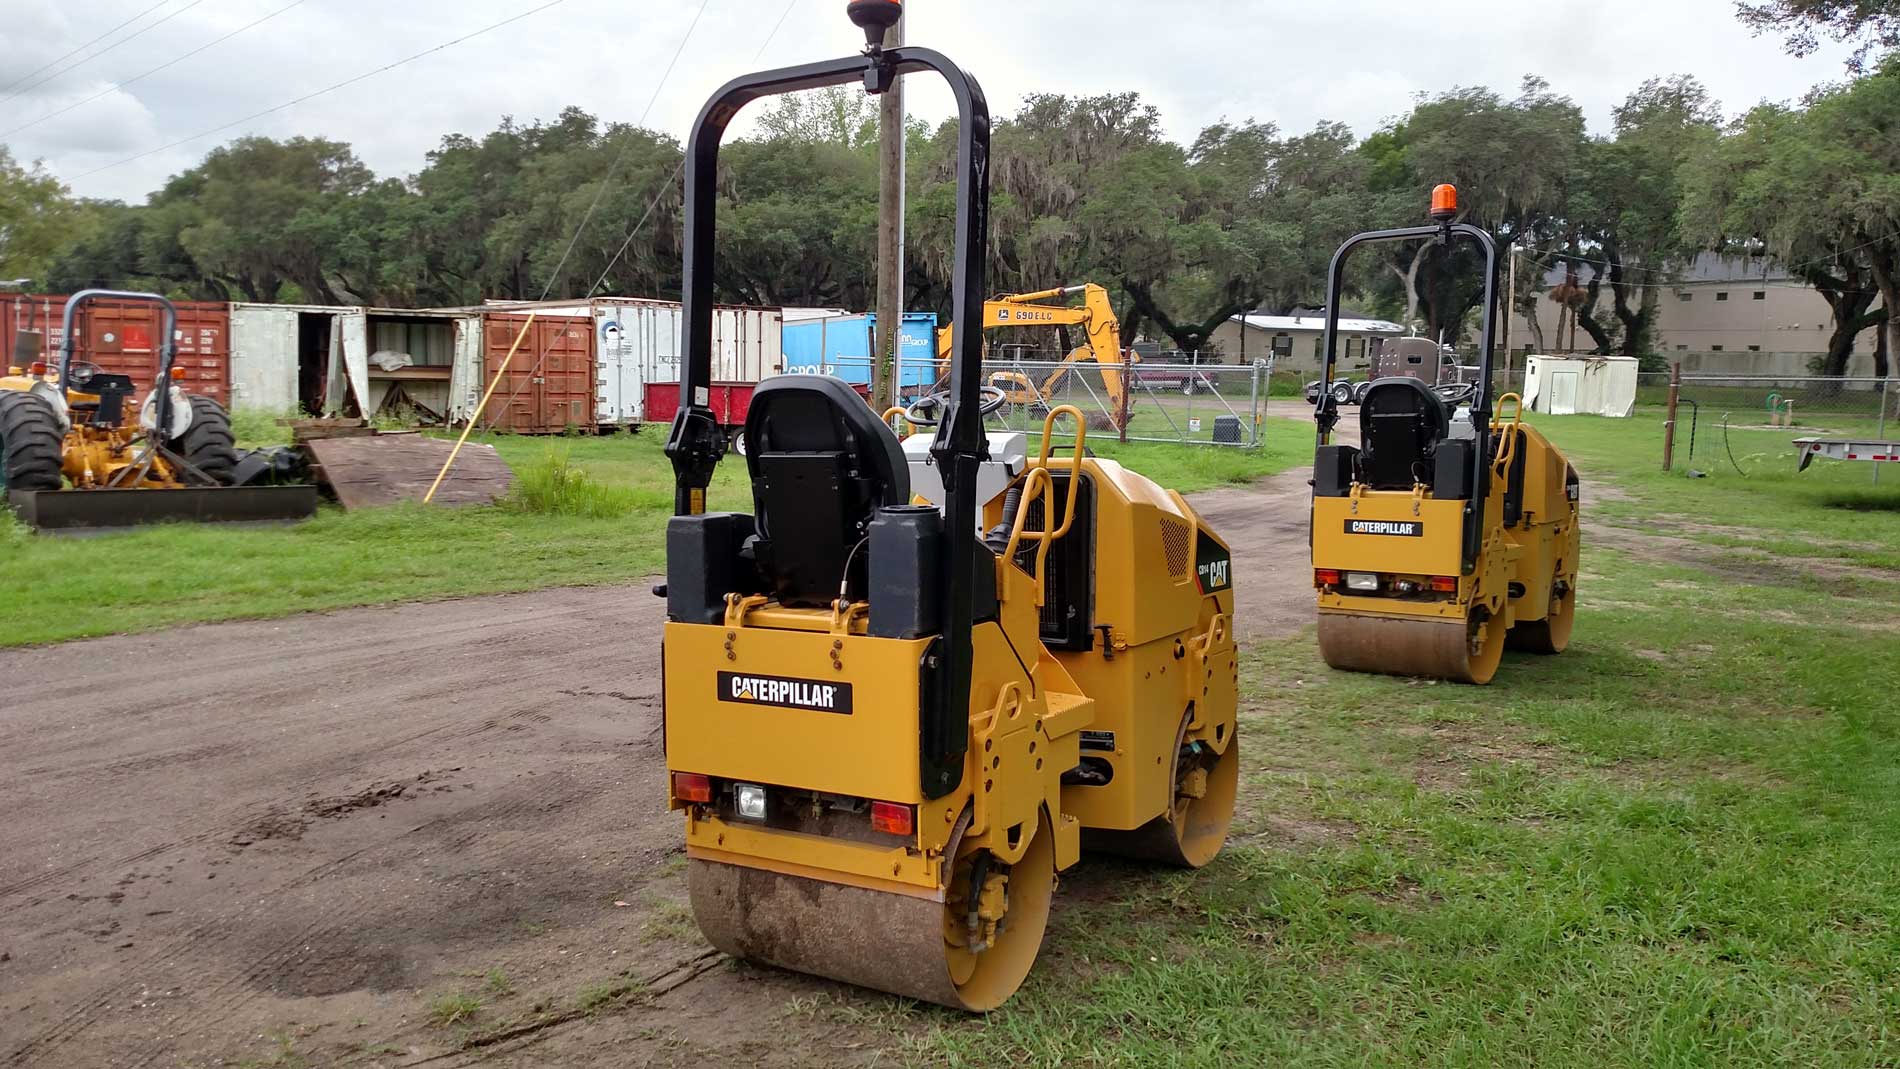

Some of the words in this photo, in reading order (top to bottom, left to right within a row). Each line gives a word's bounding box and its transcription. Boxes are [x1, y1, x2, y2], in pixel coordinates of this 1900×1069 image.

[1352, 521, 1413, 534] CATERPILLAR
[1210, 560, 1228, 588] CAT
[731, 676, 834, 708] CATERPILLAR
